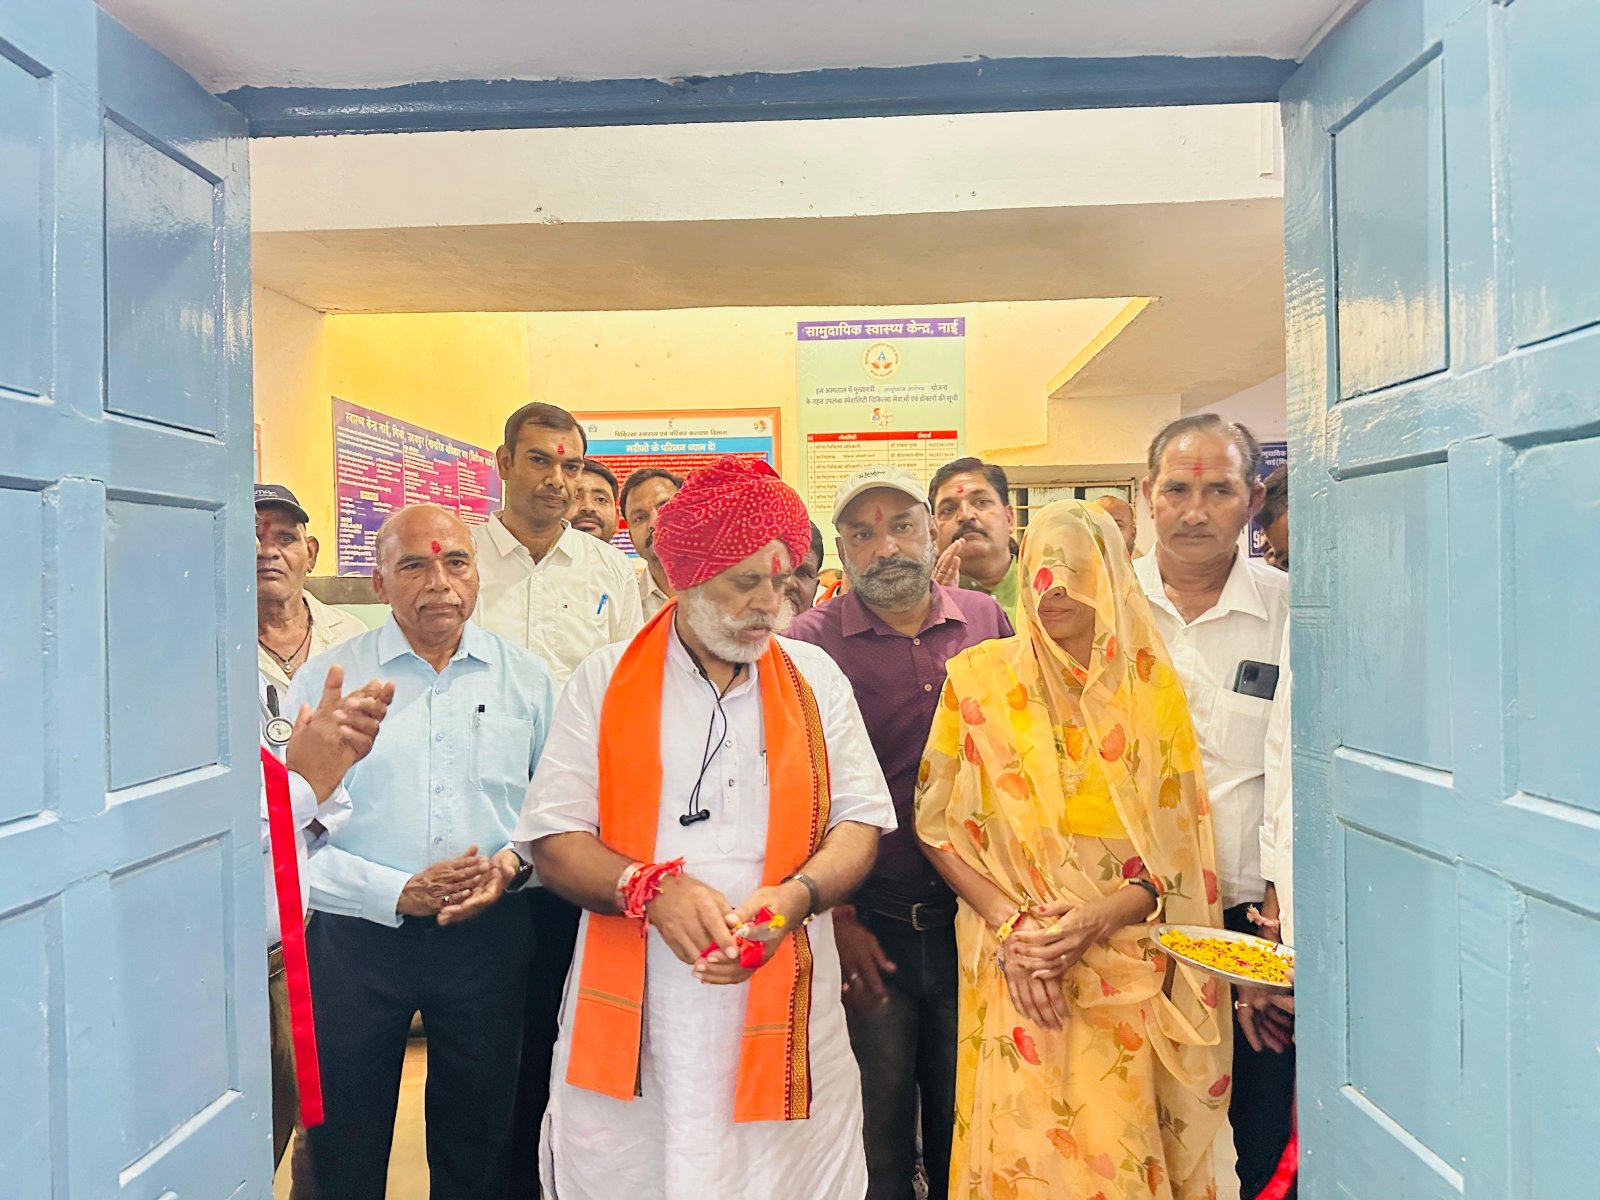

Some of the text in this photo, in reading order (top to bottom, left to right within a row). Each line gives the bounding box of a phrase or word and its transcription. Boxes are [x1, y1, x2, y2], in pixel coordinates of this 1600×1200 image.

[804, 318, 959, 339] सामुदायिक स्वास्थ्य केन्द्र, नाई
[345, 411, 365, 428] स्वास्थ्य
